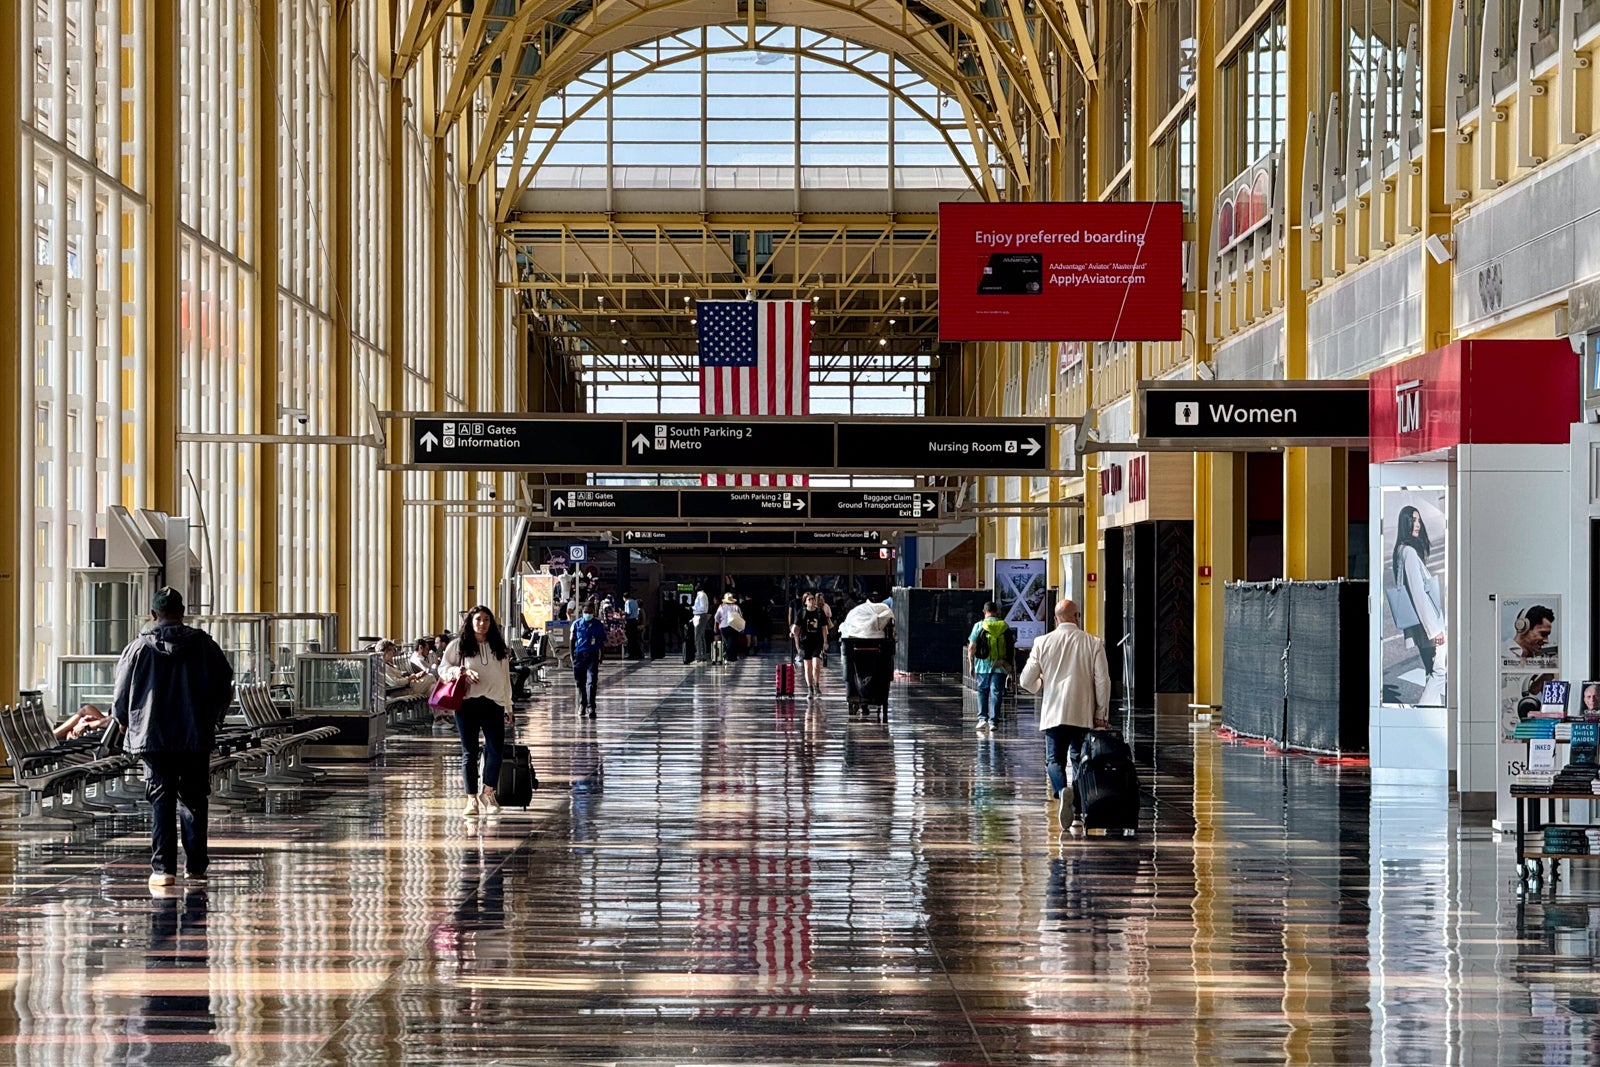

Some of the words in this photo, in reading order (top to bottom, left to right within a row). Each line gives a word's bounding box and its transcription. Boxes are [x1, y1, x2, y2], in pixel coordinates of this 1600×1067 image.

[975, 230, 1013, 247] Enjoy
[1016, 230, 1080, 247] preferred
[1084, 230, 1146, 247] boarding
[1049, 274, 1145, 286] ApplyAviator.com
[1209, 404, 1297, 422] Women
[487, 425, 516, 434] Gates
[670, 427, 700, 437] South
[704, 427, 743, 439] Parking
[746, 428, 752, 437] 2
[458, 437, 520, 447] Information
[670, 440, 702, 449] Metro
[929, 442, 968, 454] Nursing
[972, 442, 1002, 452] Room
[1507, 761, 1526, 775] iSt
